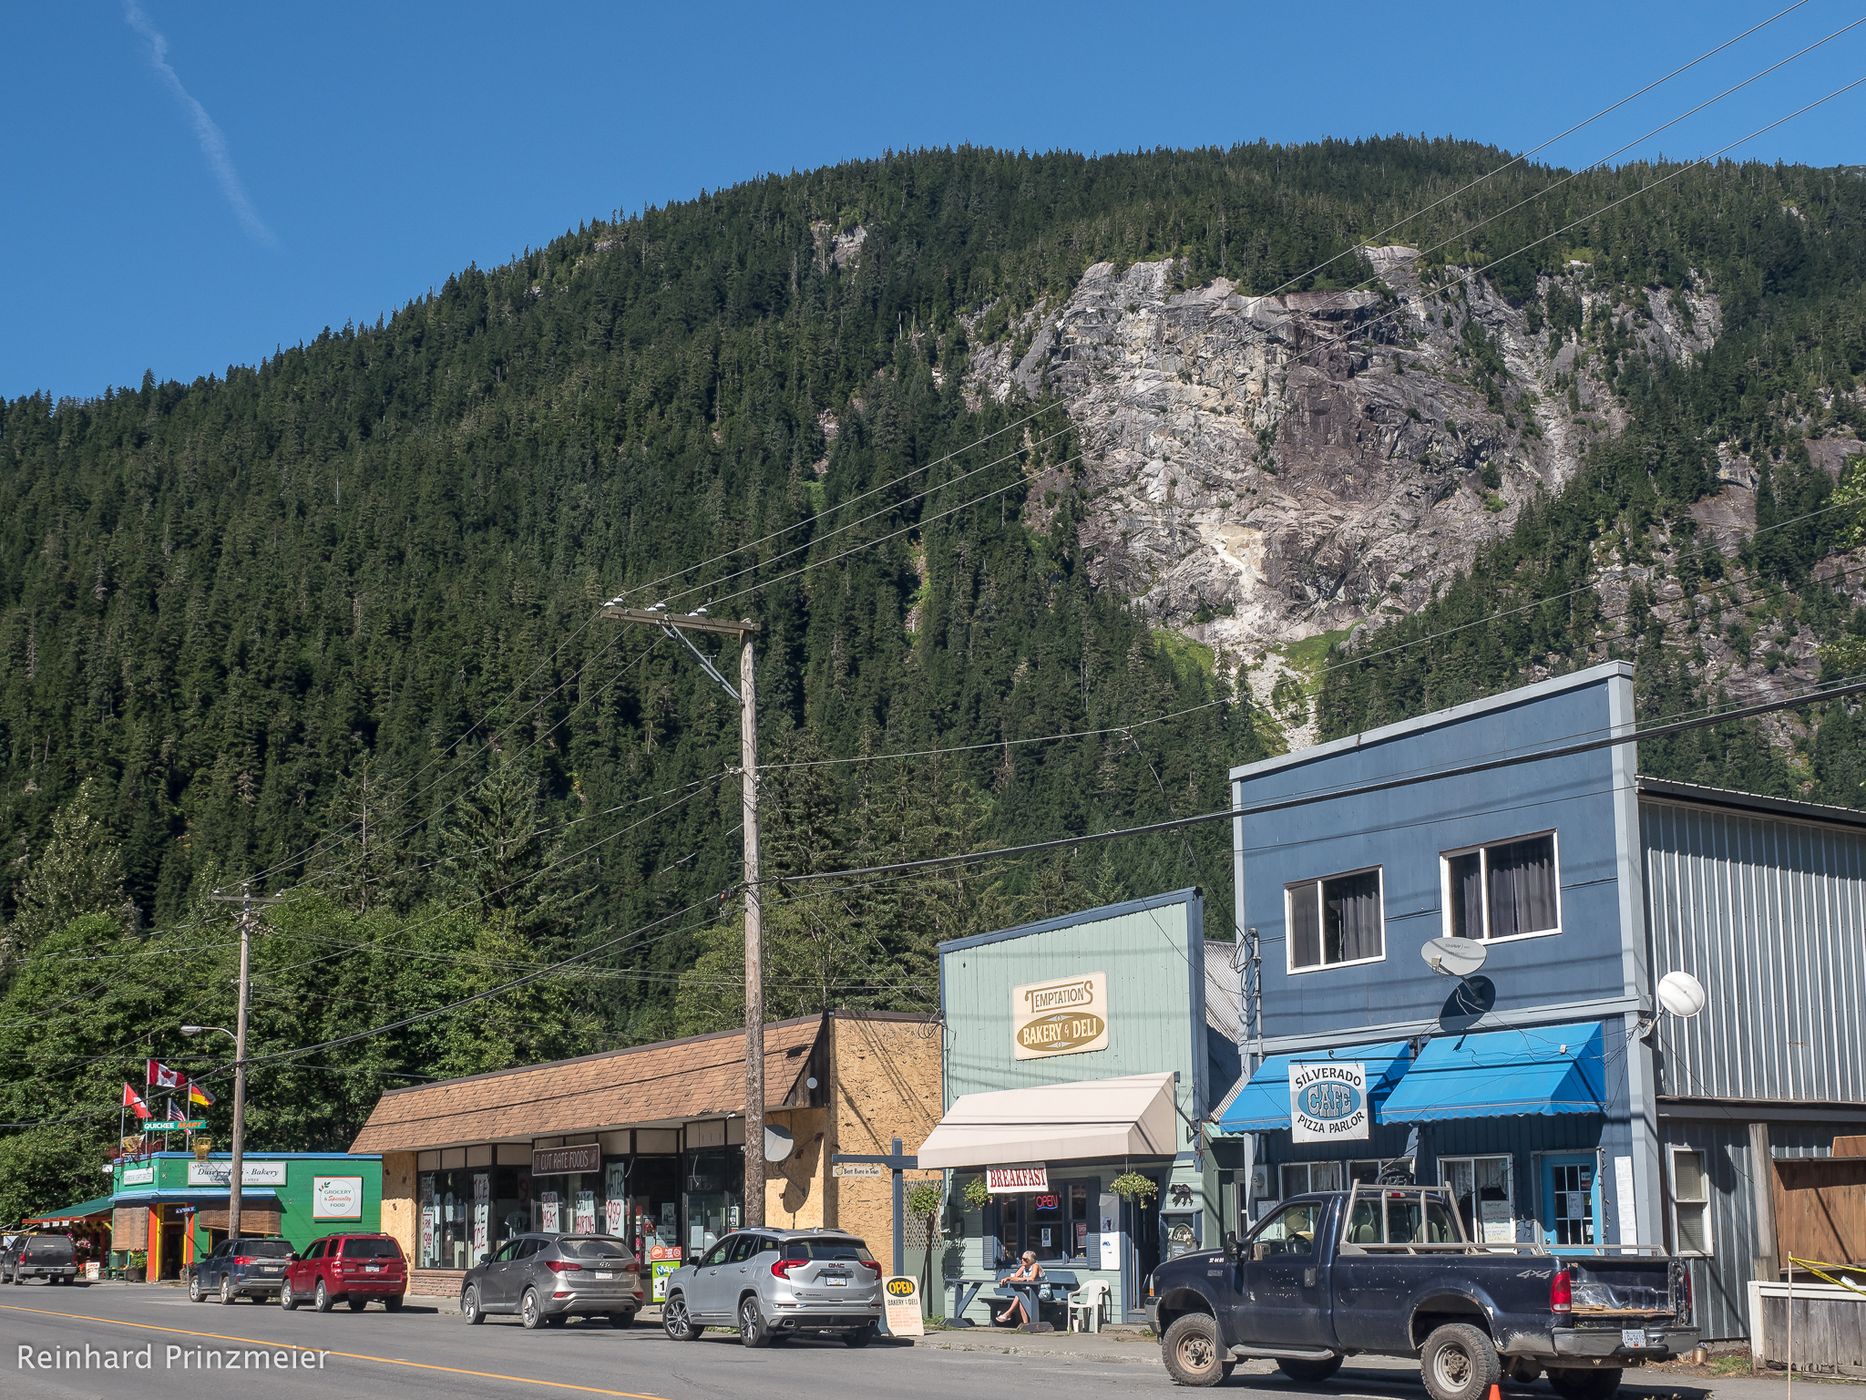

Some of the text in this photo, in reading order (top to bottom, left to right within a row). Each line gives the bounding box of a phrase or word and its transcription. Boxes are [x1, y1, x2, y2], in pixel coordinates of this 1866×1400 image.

[1025, 980, 1093, 1013] TEMPTATIONS
[1022, 1022, 1062, 1045] BAKERY
[1073, 1018, 1097, 1039] DELI
[1295, 1067, 1361, 1089] SILVERADO
[1307, 1083, 1352, 1118] CAFE
[1297, 1111, 1365, 1134] PIZZA PARLOR
[541, 1154, 553, 1170] CUT
[553, 1151, 569, 1169] RATE
[251, 1168, 279, 1177] Bakery
[990, 1166, 1047, 1188] BREAKFAST
[1036, 1194, 1059, 1208] OPEN
[888, 1280, 914, 1295] OPEN
